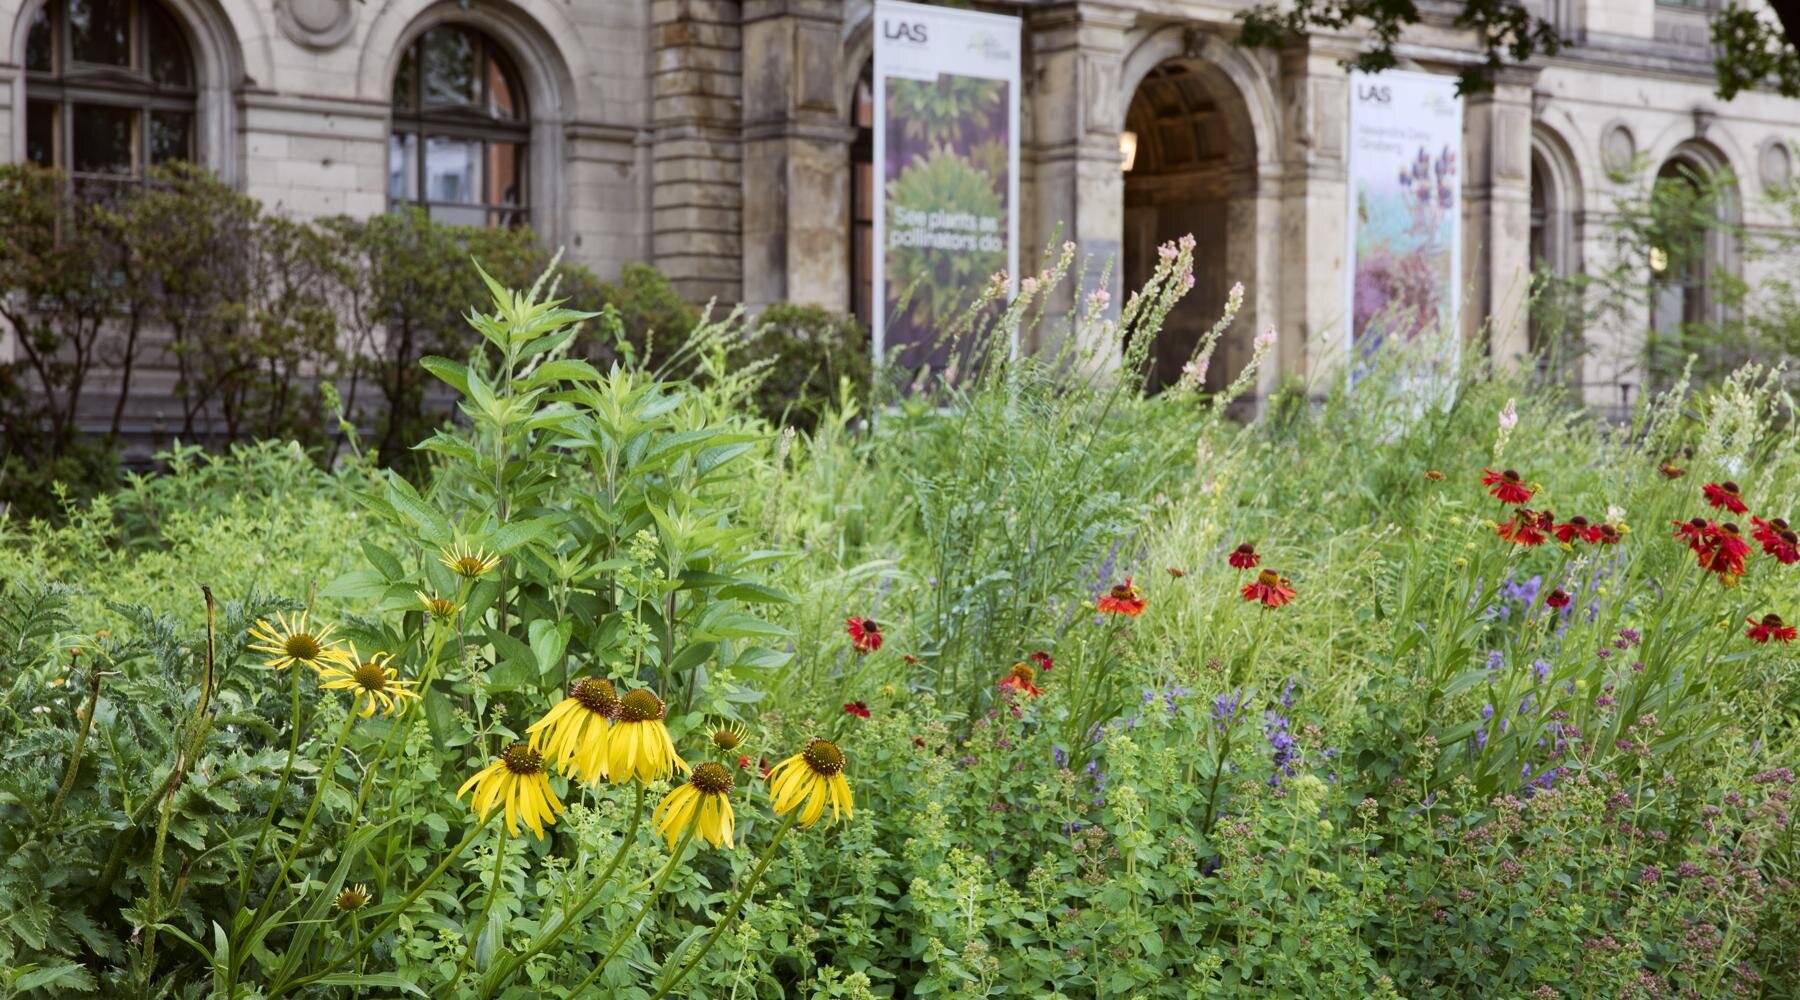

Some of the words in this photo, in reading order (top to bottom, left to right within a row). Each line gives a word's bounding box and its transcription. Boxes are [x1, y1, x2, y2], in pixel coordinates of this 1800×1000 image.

[884, 20, 928, 43] LAS
[1359, 83, 1391, 103] LAS
[895, 205, 926, 226] See
[928, 208, 978, 231] plants
[890, 226, 978, 251] pollinators
[979, 232, 1002, 252] do
